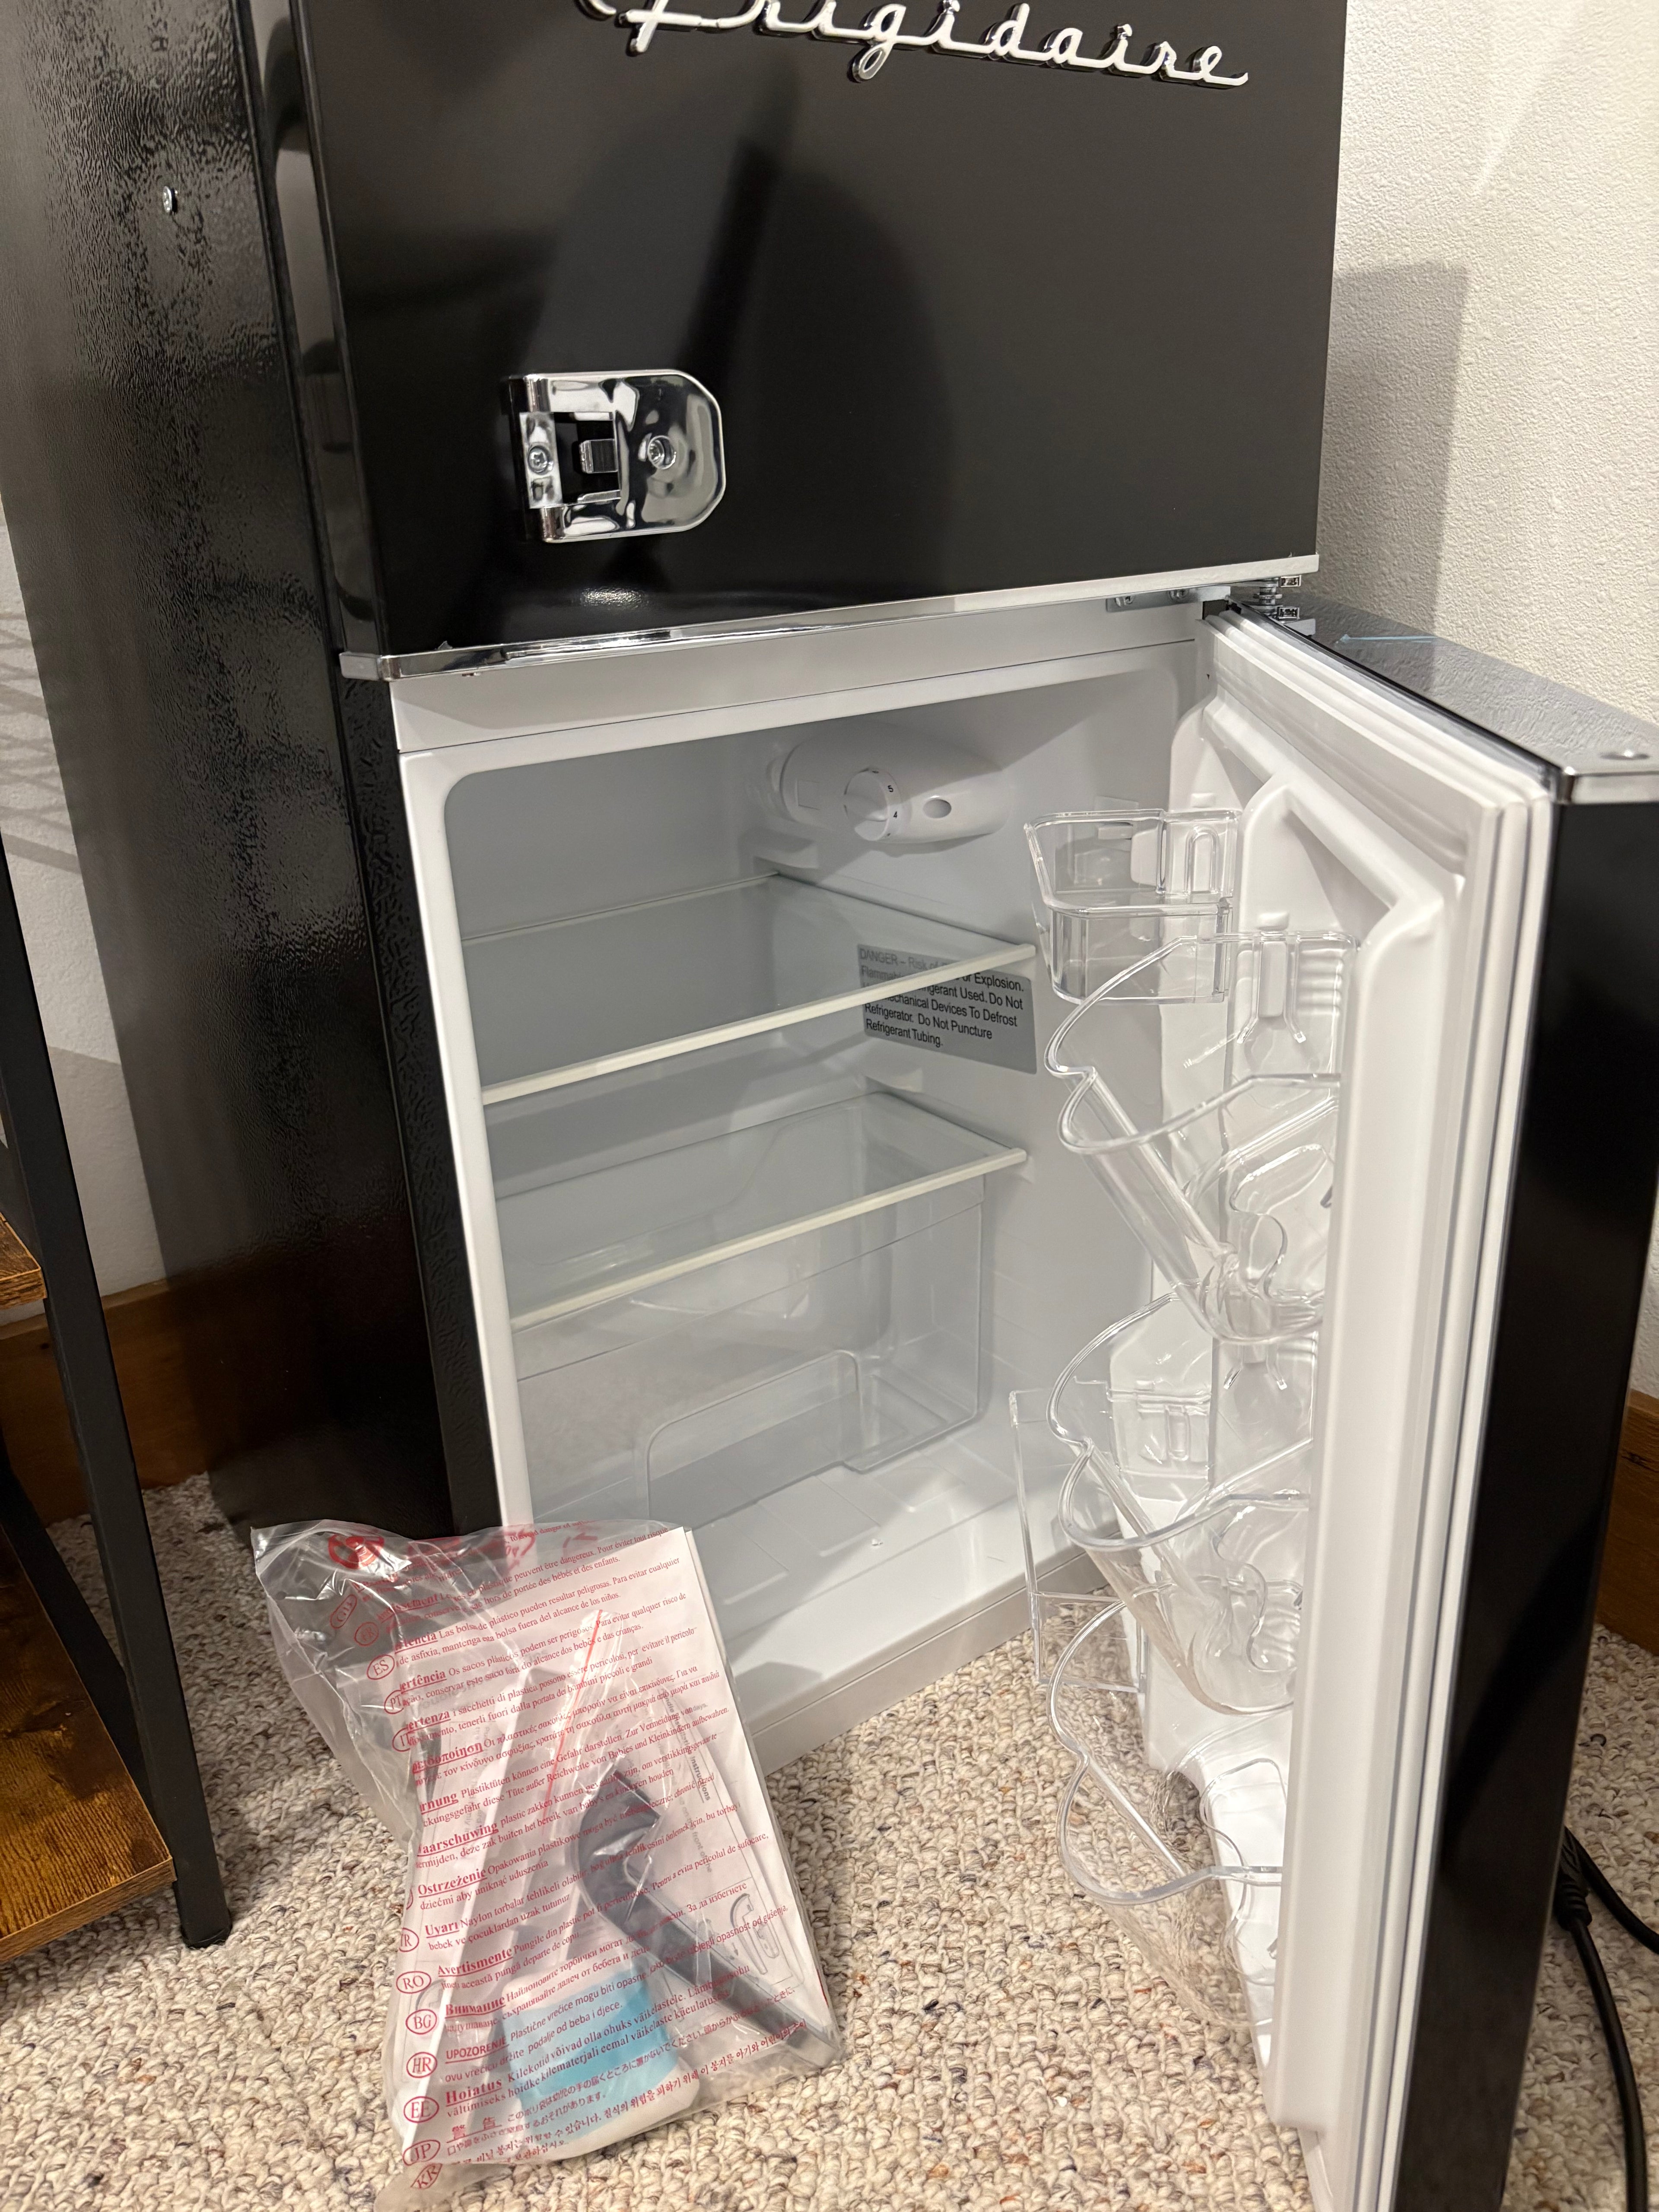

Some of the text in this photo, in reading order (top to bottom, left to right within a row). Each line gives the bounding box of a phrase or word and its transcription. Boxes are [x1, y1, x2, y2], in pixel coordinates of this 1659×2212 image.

[860, 949, 898, 965] DANGER
[909, 957, 927, 969] Risk
[975, 973, 1024, 992] Explosion.
[865, 1003, 992, 1039] Refrigerator. Do Not Puncture
[885, 995, 1017, 1027] echanical Devices To Defrost
[960, 987, 987, 1003] Used.
[989, 993, 1002, 1006] Do
[1006, 997, 1023, 1010] Not
[866, 1020, 943, 1047] Refrigerant Tubing.
[513, 1539, 632, 1583] peuvent dangereux. éviter
[513, 1583, 536, 1597] portée
[552, 1571, 572, 1581] bébés
[594, 1555, 620, 1569] enfants.
[439, 1630, 454, 1639] Las
[489, 1612, 518, 1628] plástico
[520, 1602, 547, 1617] pueden
[548, 1592, 575, 1605] resultar
[577, 1579, 612, 1597] peligrosas.
[628, 1570, 646, 1580] evitar
[648, 1559, 679, 1573] cualquier
[412, 1647, 440, 1661] asfixia,
[442, 1637, 481, 1653] mantenga
[496, 1627, 517, 1639] bolsa
[517, 1620, 537, 1629] fuera
[553, 1605, 578, 1618] alcance
[601, 1591, 620, 1602] niños.
[448, 1668, 460, 1676] Os
[462, 1662, 484, 1672] sacos
[521, 1642, 545, 1656] podem
[612, 1613, 629, 1623] evitar
[631, 1602, 660, 1618] qualquer
[662, 1597, 677, 1605] risco
[370, 1660, 392, 1677] ES
[426, 1683, 464, 1698] conservar
[534, 1652, 558, 1665] alcance
[560, 1647, 572, 1656] dos
[615, 1623, 643, 1636] crianças.
[458, 1629, 694, 1714] sacchetti di plastica possono evitare pericolo
[458, 1658, 652, 1730] tenerli fuori dalla portata grandi
[572, 1700, 605, 1717] μπορούν
[619, 1689, 638, 1700] είναι
[676, 1670, 688, 1678] Για
[443, 1767, 458, 1777] τον
[460, 1756, 494, 1771] κίνδυνο
[613, 1705, 632, 1717] αυτή
[461, 1714, 679, 1798] Plastiktüten können eine Gefahr Vermeidung
[482, 1796, 503, 1808] diese
[547, 1763, 588, 1784] Reichweite
[634, 1740, 647, 1749] und
[648, 1724, 690, 1743] Kleinkindern
[691, 1707, 730, 1728] aufbewahren.
[460, 1769, 673, 1858] deze buiten bereik houden
[500, 1789, 583, 1828] plastic zakken kunnen
[418, 1833, 579, 1895] Ostrzeżenie Opakowania plastikowe
[421, 1862, 548, 1910] dziećmi uduszenia
[429, 1897, 568, 1951] bebek çocuklardan tutunuz
[438, 1850, 725, 1975] Avertismente plastic pericolul
[460, 1884, 558, 1926] Naylon torbalar tehlikeli
[523, 1948, 550, 1967] departe
[581, 1968, 590, 1977] от
[404, 1975, 425, 1992] RO
[447, 1923, 749, 2060] UPOZORENJE mogu biti opasnost
[414, 2014, 433, 2030] BG
[569, 1999, 623, 2028] beba djece.
[413, 2056, 433, 2075] HR
[448, 2019, 632, 2102] Hoiatus võivad olla ohuks
[508, 2036, 629, 2098] hoidke eemal
[657, 2080, 680, 2095] 피하기
[701, 2066, 709, 2075] 이
[736, 2042, 759, 2057] 아기와
[411, 2099, 430, 2120] EE
[413, 2145, 431, 2161] JP
